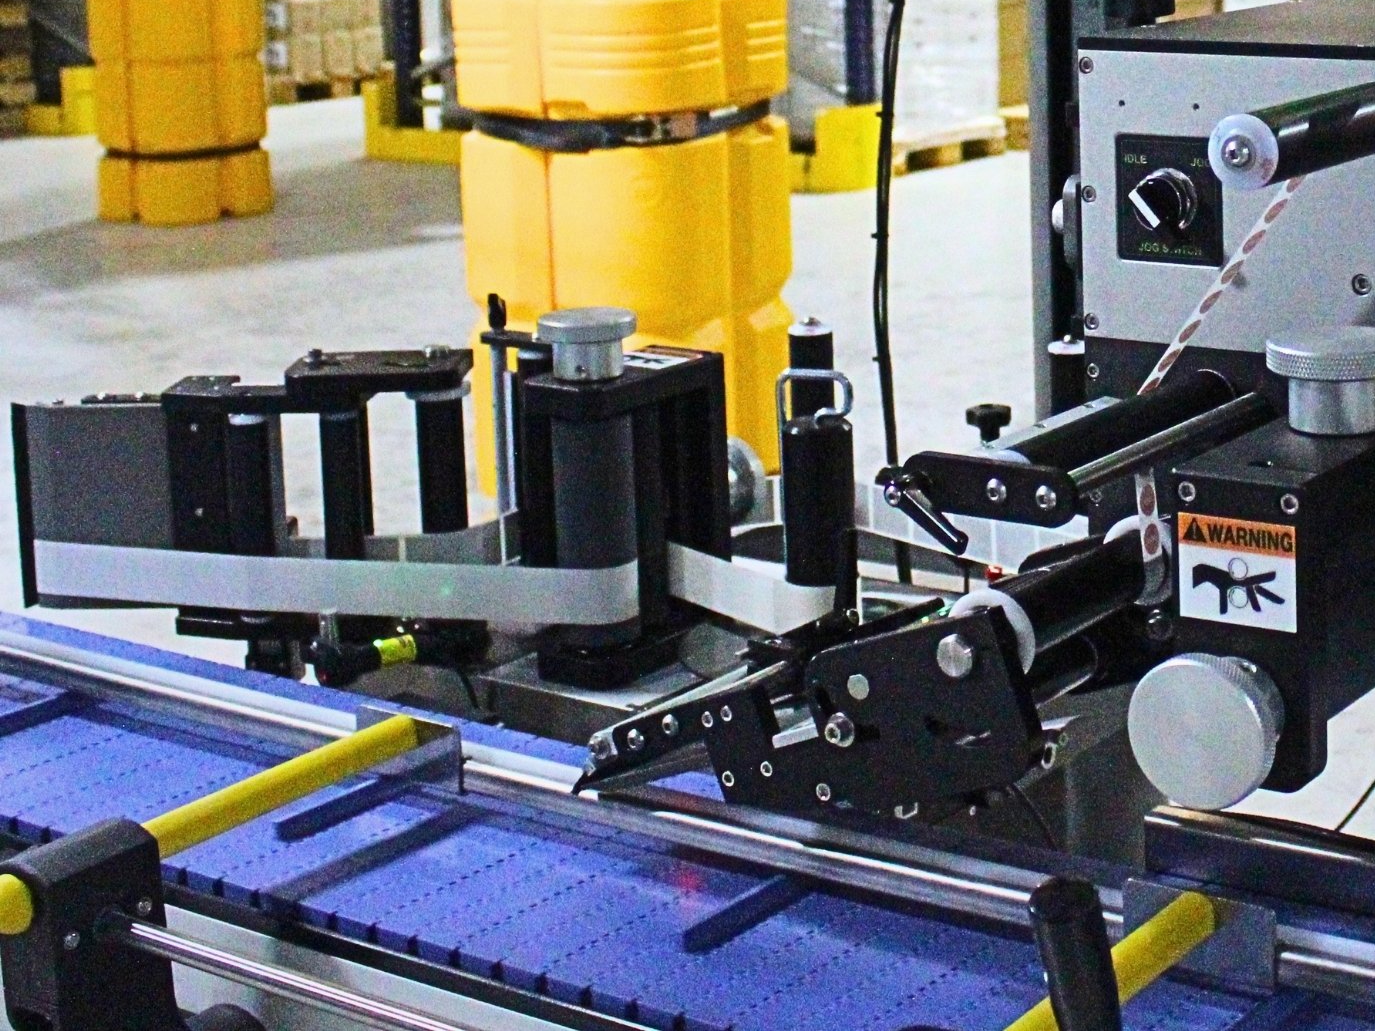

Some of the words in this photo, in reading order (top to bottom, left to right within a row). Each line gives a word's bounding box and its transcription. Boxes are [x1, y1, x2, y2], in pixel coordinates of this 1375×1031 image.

[1124, 153, 1148, 164] IDLE
[1139, 242, 1159, 253] JOG
[1207, 522, 1293, 553] WARNING
